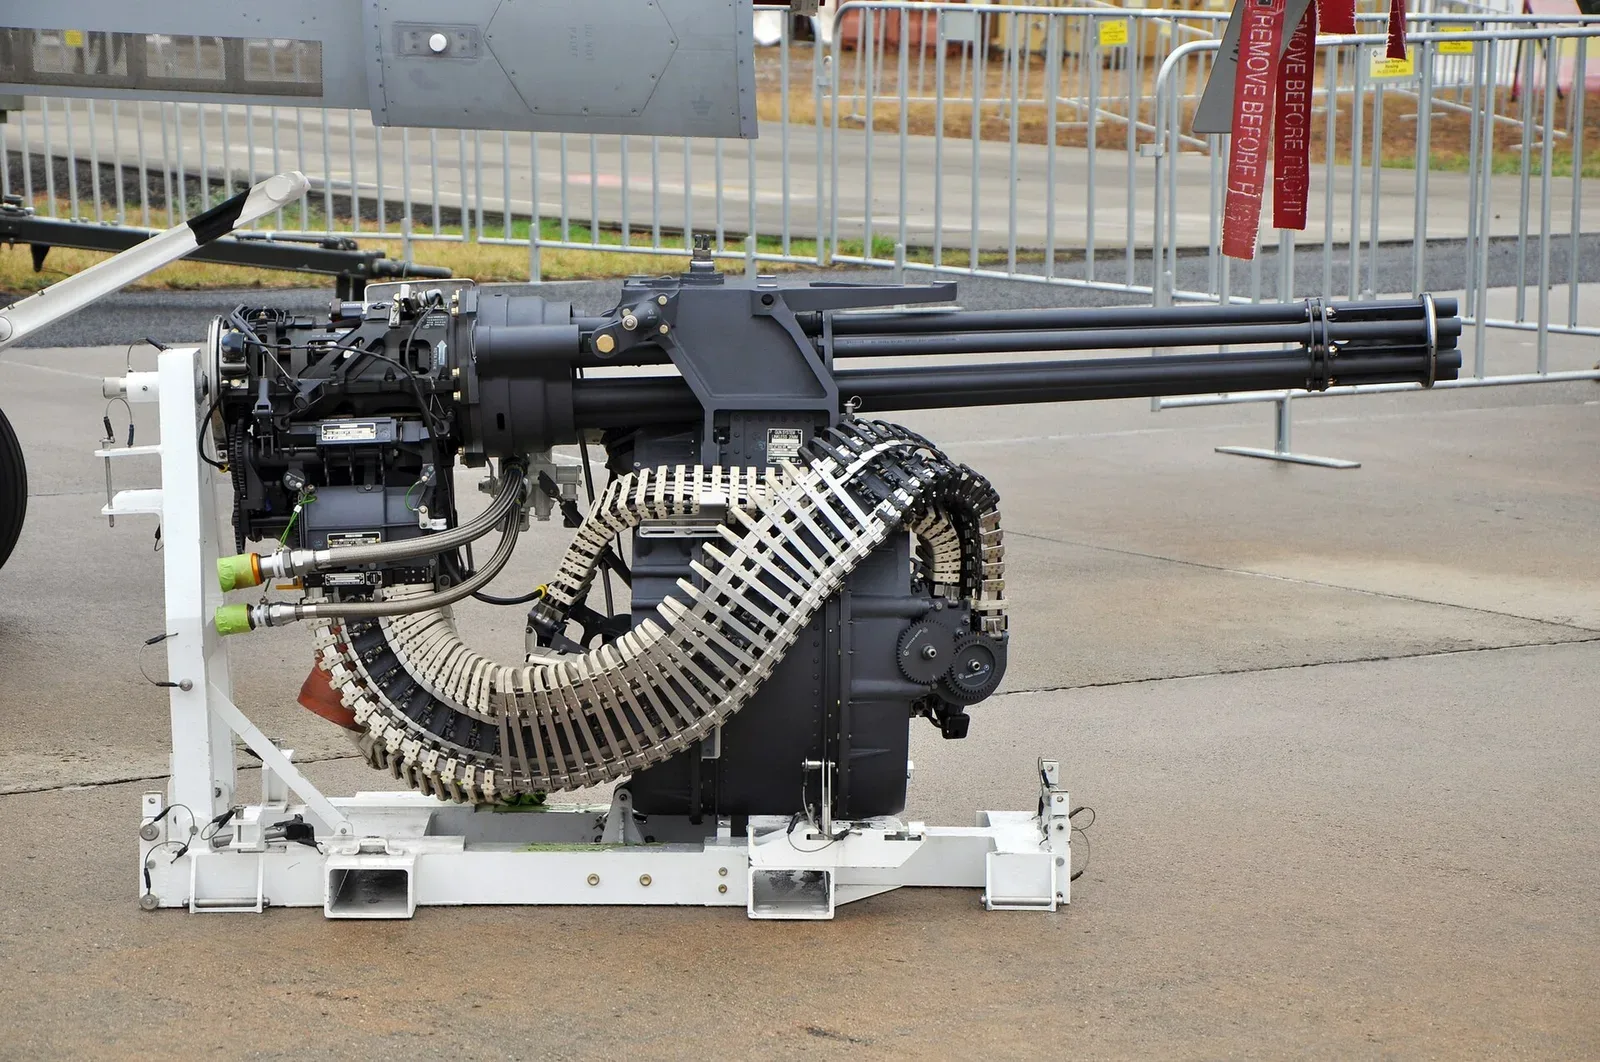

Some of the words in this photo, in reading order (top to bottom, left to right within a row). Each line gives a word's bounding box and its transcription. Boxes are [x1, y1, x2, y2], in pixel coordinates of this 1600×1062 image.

[1243, 15, 1274, 96] REMOVE
[1285, 14, 1307, 74] MOVE
[1235, 101, 1264, 177] BEFORE
[1284, 81, 1305, 149] BEFORE
